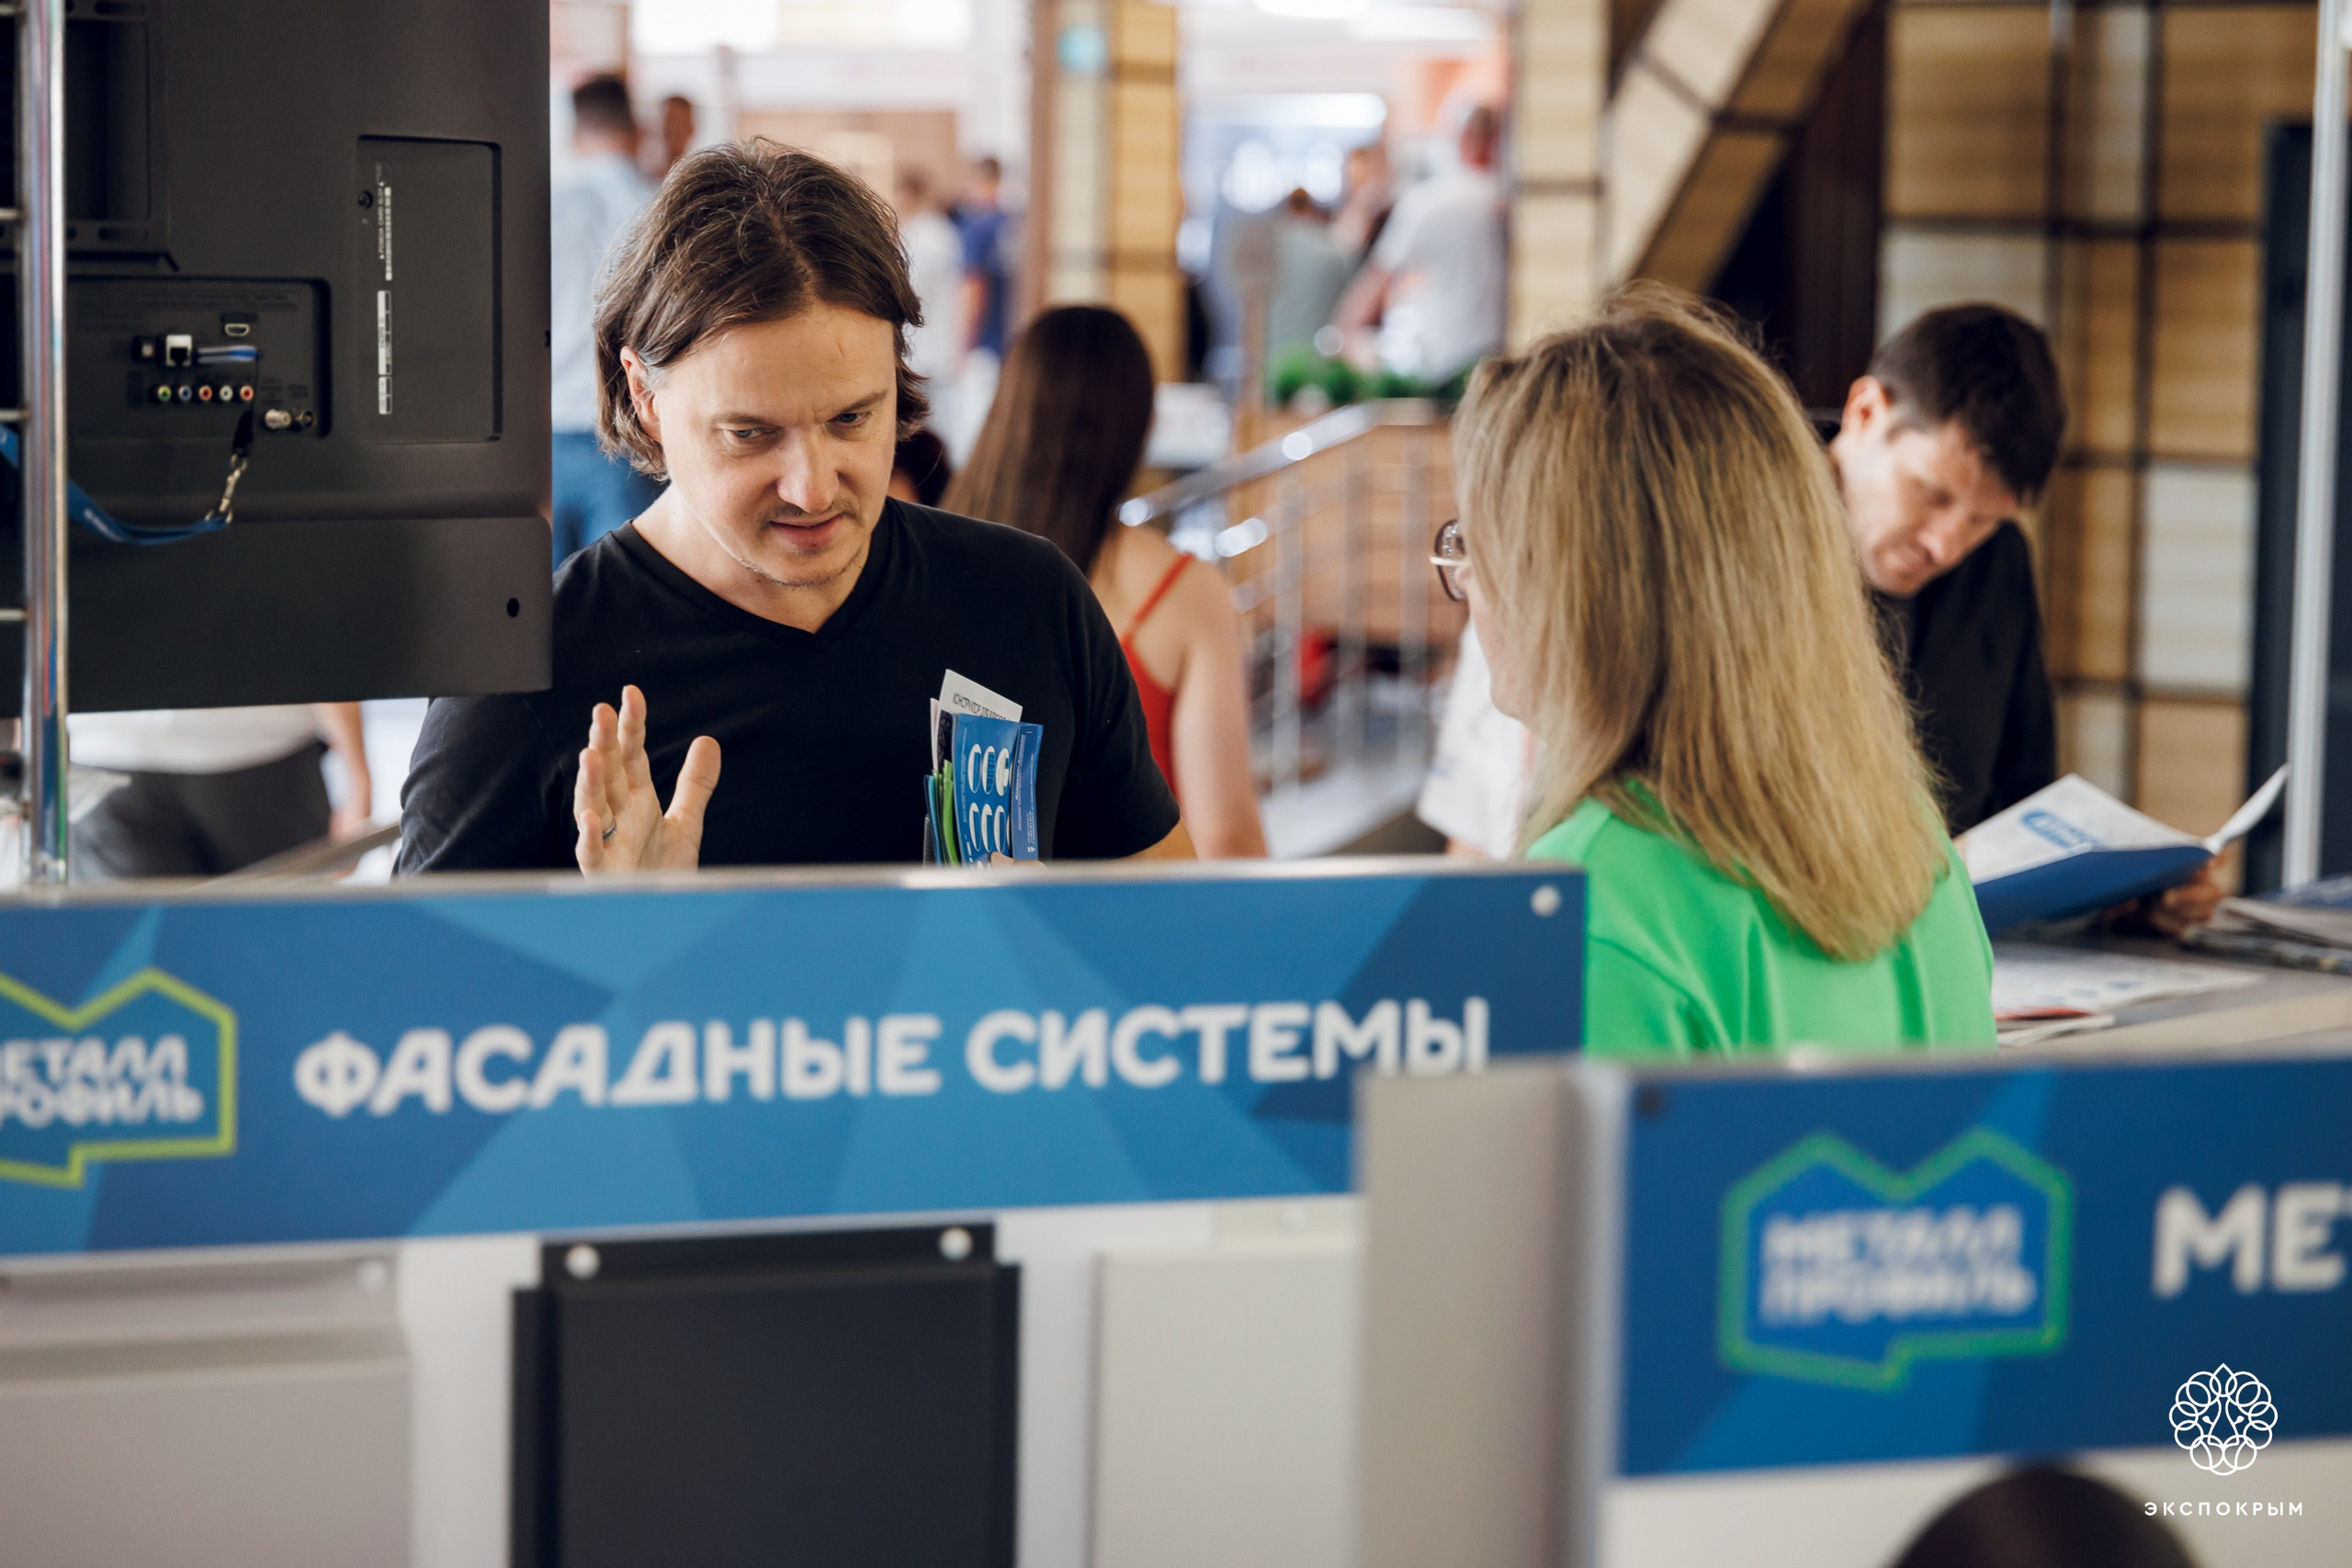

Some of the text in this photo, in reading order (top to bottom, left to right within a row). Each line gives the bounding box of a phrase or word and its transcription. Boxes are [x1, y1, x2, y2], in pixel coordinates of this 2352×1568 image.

[0, 1035, 189, 1084] ЕТАЛЛ
[293, 998, 1489, 1117] ФАСАДНЫЕ СИСТЕМЫ
[0, 1082, 205, 1128] РОФИЛЬ
[1761, 1204, 2024, 1269] МЕТАЛЛ
[2152, 1181, 2352, 1300] МЕ
[1758, 1264, 2038, 1325] ПРОФИЛЬ
